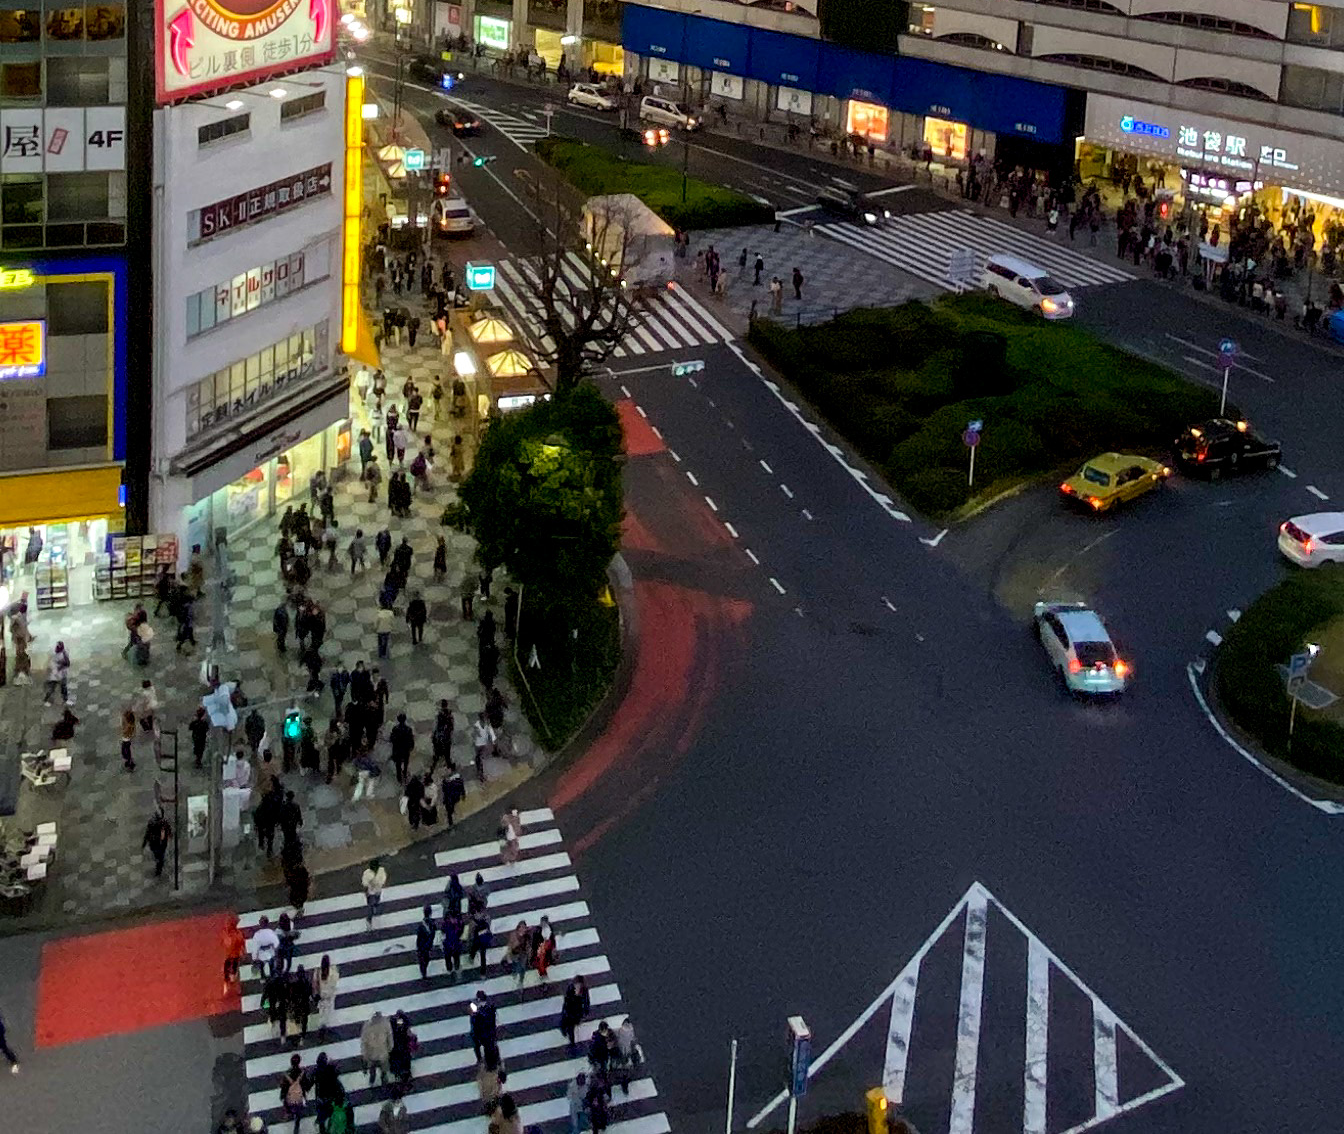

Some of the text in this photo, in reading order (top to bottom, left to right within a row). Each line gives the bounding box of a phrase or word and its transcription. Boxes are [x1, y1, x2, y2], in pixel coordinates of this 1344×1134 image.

[263, 32, 313, 61] 徒歩1分
[88, 130, 124, 148] 4F
[1178, 126, 1247, 157] 池袋駅
[217, 253, 303, 305] ネイルサロン
